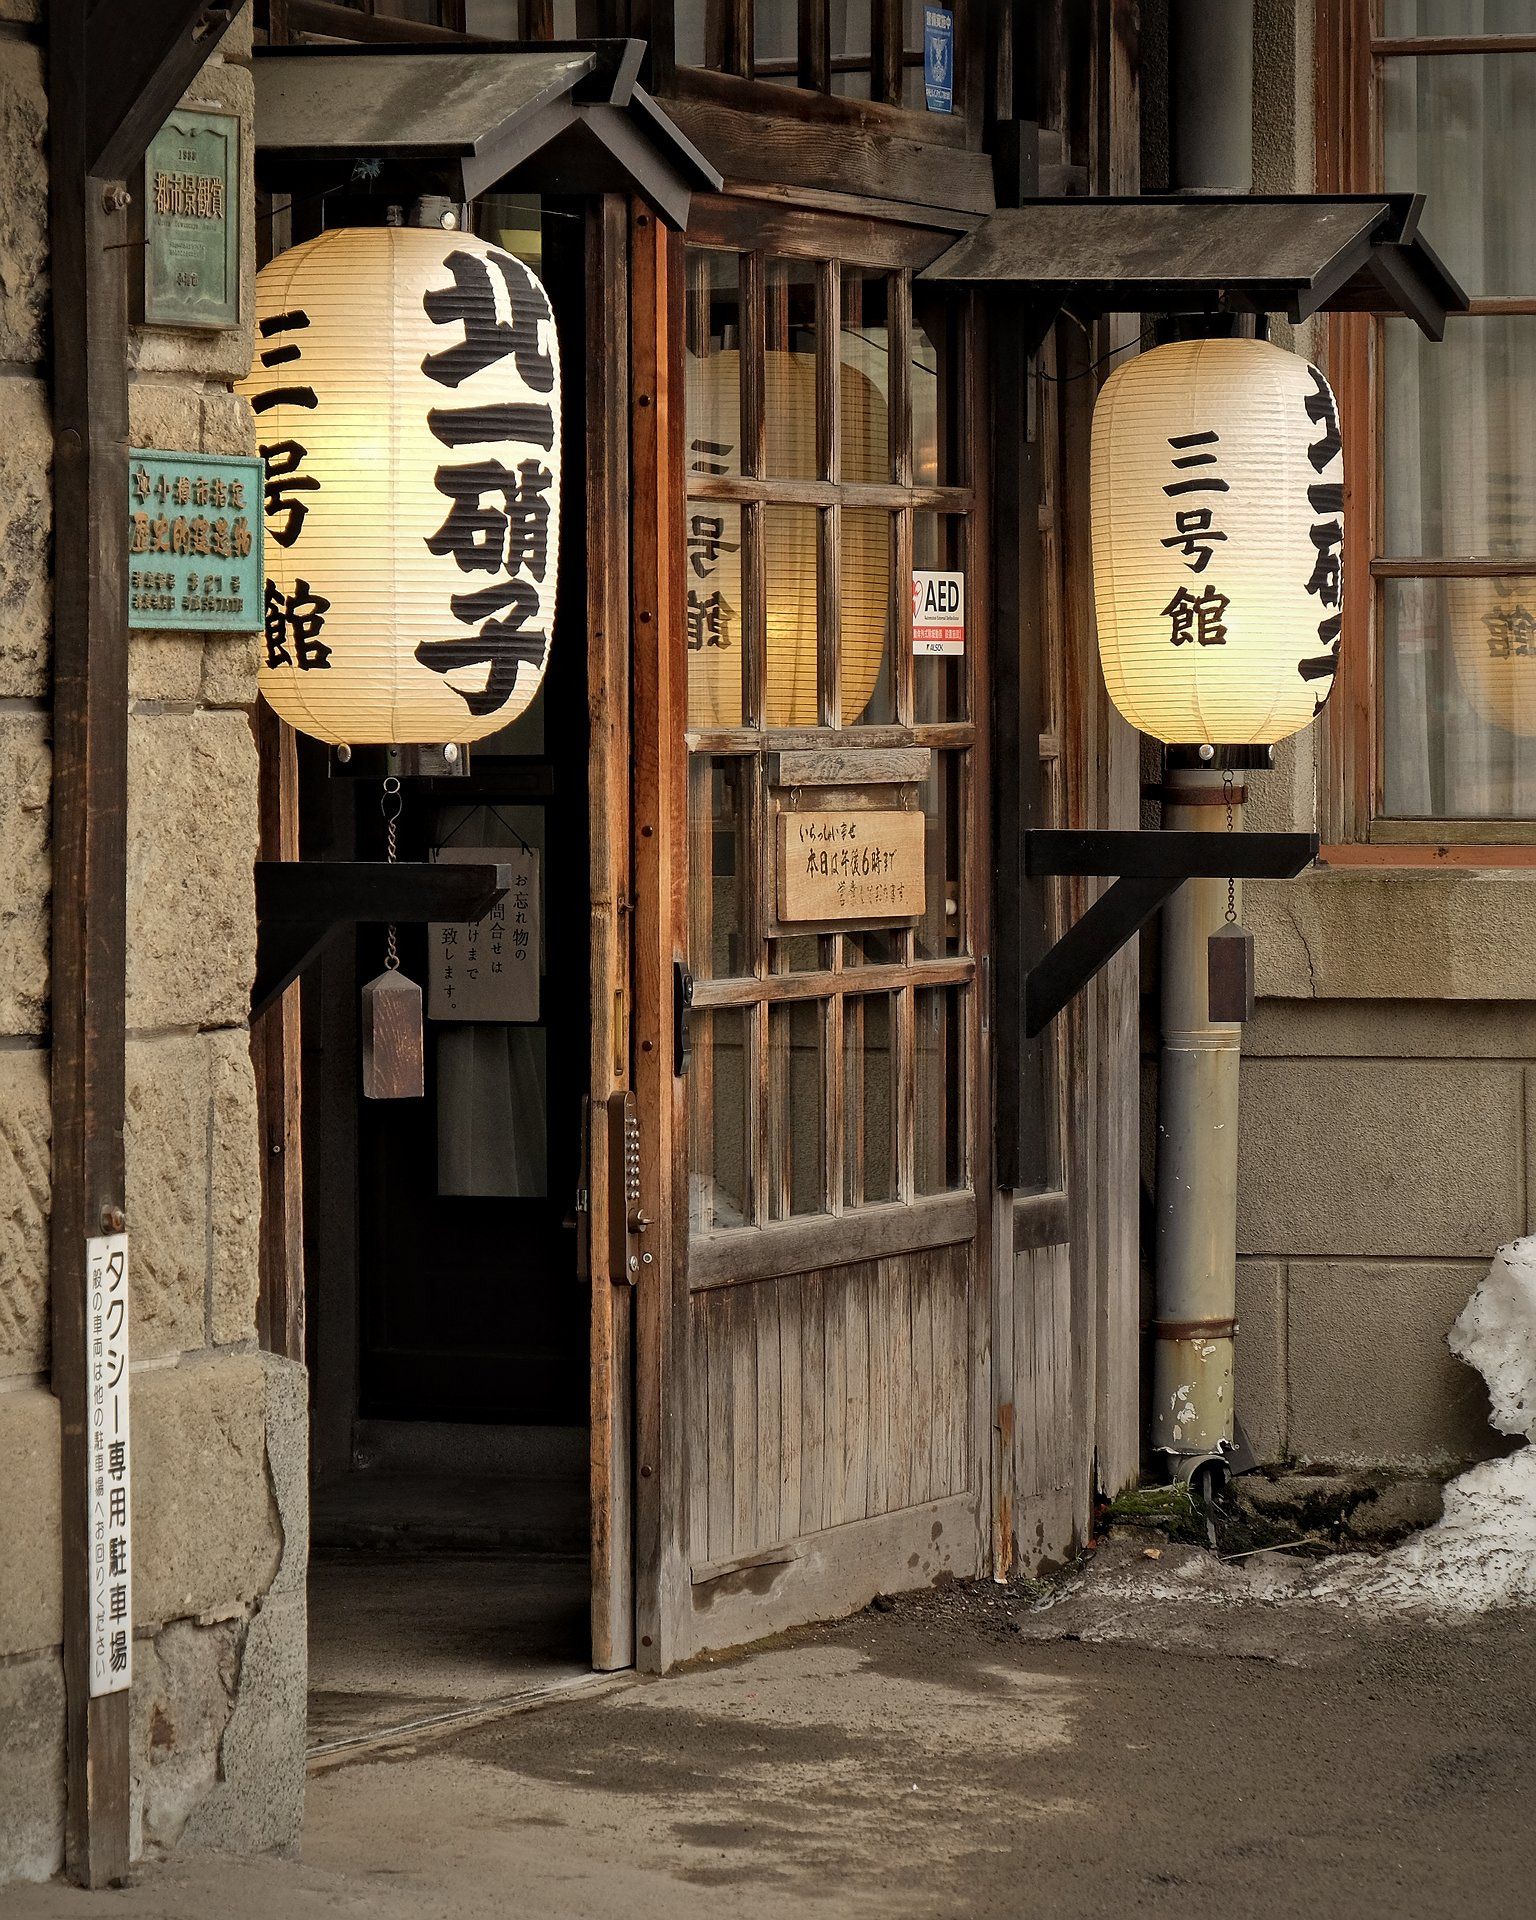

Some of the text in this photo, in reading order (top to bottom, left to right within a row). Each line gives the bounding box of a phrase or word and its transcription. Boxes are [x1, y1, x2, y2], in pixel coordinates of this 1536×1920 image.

[154, 172, 224, 219] 都市景観賞
[130, 511, 253, 558] 歴史的建造物
[251, 309, 333, 671] 三号館
[414, 249, 555, 716] 北一硝子
[1159, 430, 1231, 647] 三号館
[925, 580, 960, 612] AED
[513, 874, 529, 962] お忘れ物の
[105, 1250, 127, 1674] タクシー専用駐車場
